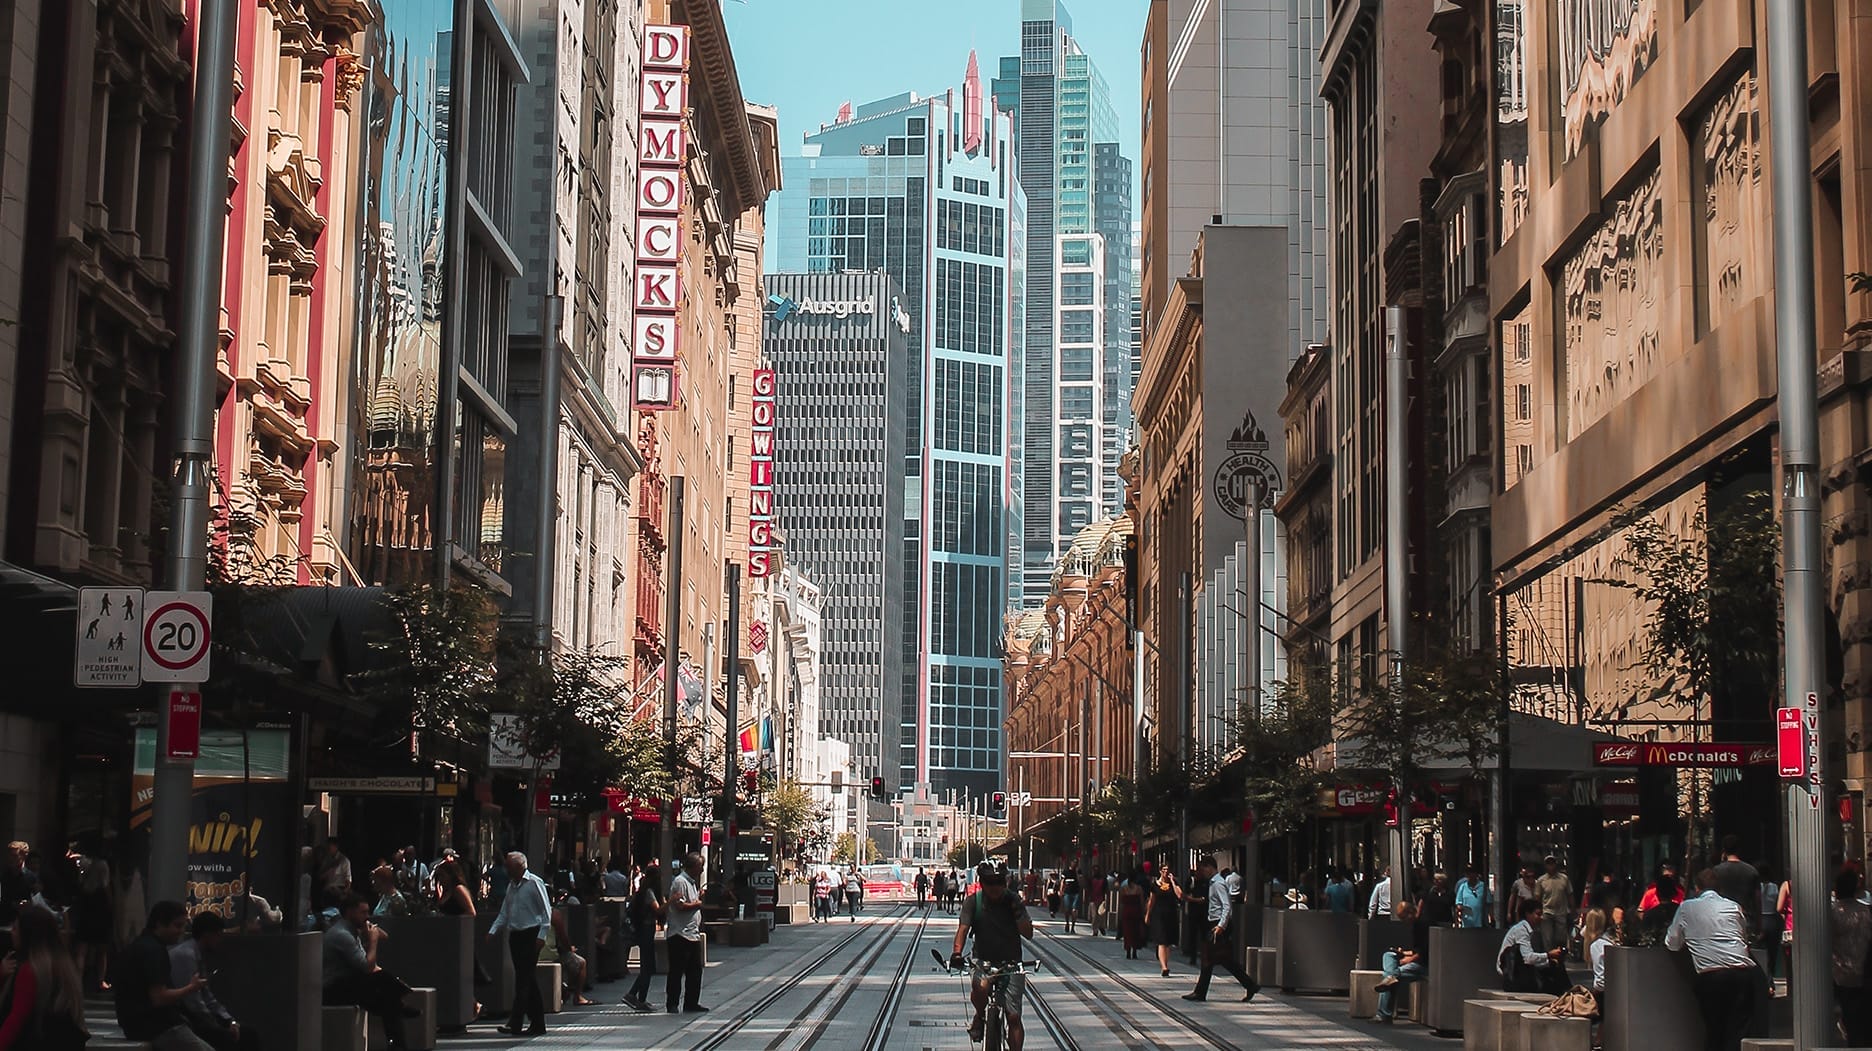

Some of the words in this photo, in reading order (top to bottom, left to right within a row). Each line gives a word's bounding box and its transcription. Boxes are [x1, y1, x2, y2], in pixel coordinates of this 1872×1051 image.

[641, 32, 679, 356] DYMOCKS
[799, 295, 874, 319] Ausgrid
[1226, 456, 1270, 472] HEALTH
[752, 372, 773, 577] GOWINGS
[1218, 486, 1240, 514] CARE
[159, 622, 196, 651] 20
[84, 664, 134, 672] PEDESTRIAN
[90, 673, 128, 681] ACTIVITY
[174, 704, 198, 712] STOPPING
[1749, 749, 1777, 764] McCa
[137, 787, 155, 802] NE
[203, 864, 225, 872] with
[185, 872, 248, 899] ramel
